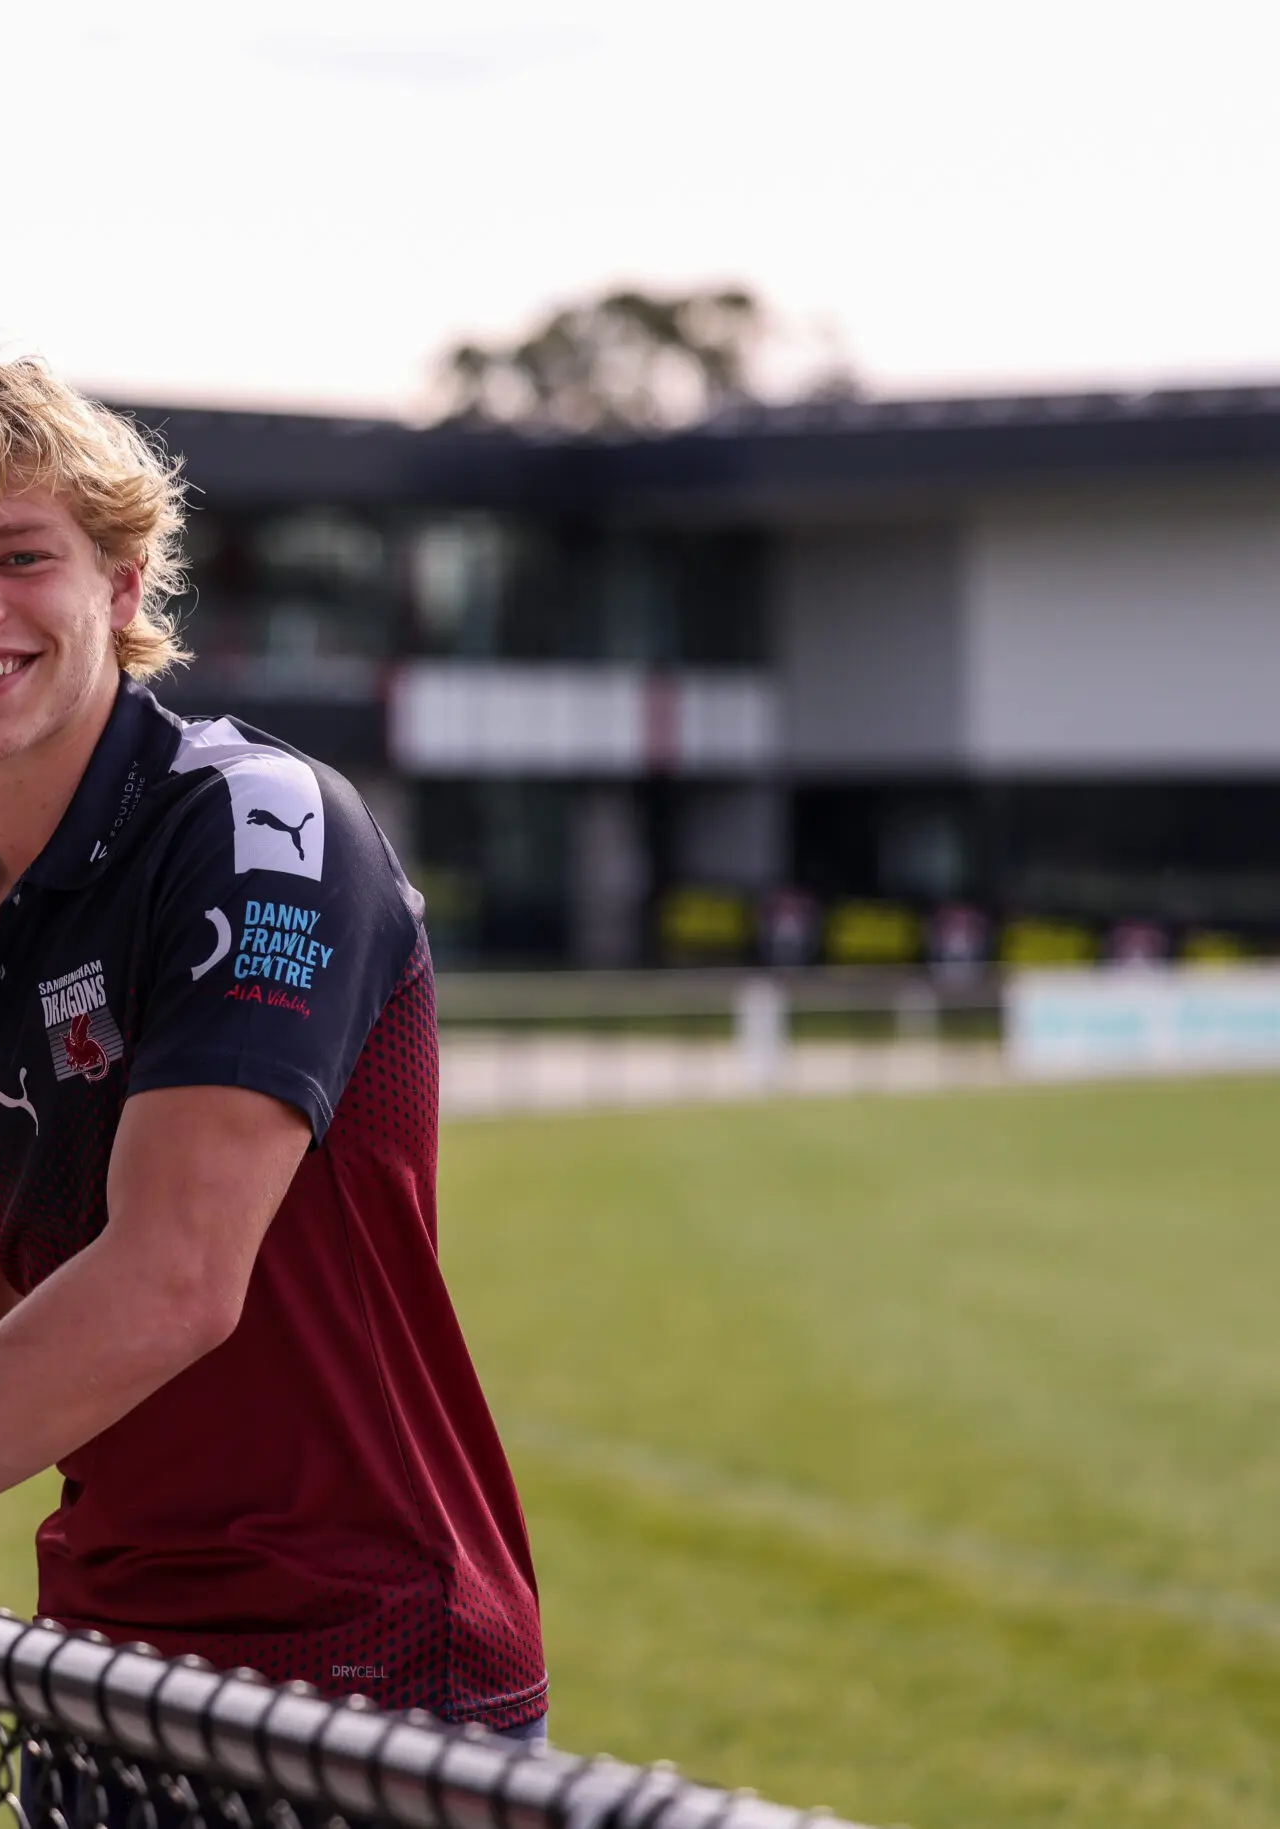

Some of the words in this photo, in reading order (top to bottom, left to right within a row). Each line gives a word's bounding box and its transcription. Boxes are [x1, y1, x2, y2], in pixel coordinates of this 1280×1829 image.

[245, 900, 321, 935] DANNY
[240, 927, 334, 969] FRAWLEY
[39, 959, 103, 995] SANDRINGHAM
[234, 953, 314, 990] CENTRE
[41, 974, 107, 1028] DRAGONS
[267, 988, 312, 1020] Vitality
[332, 1665, 390, 1679] DRYCELL
